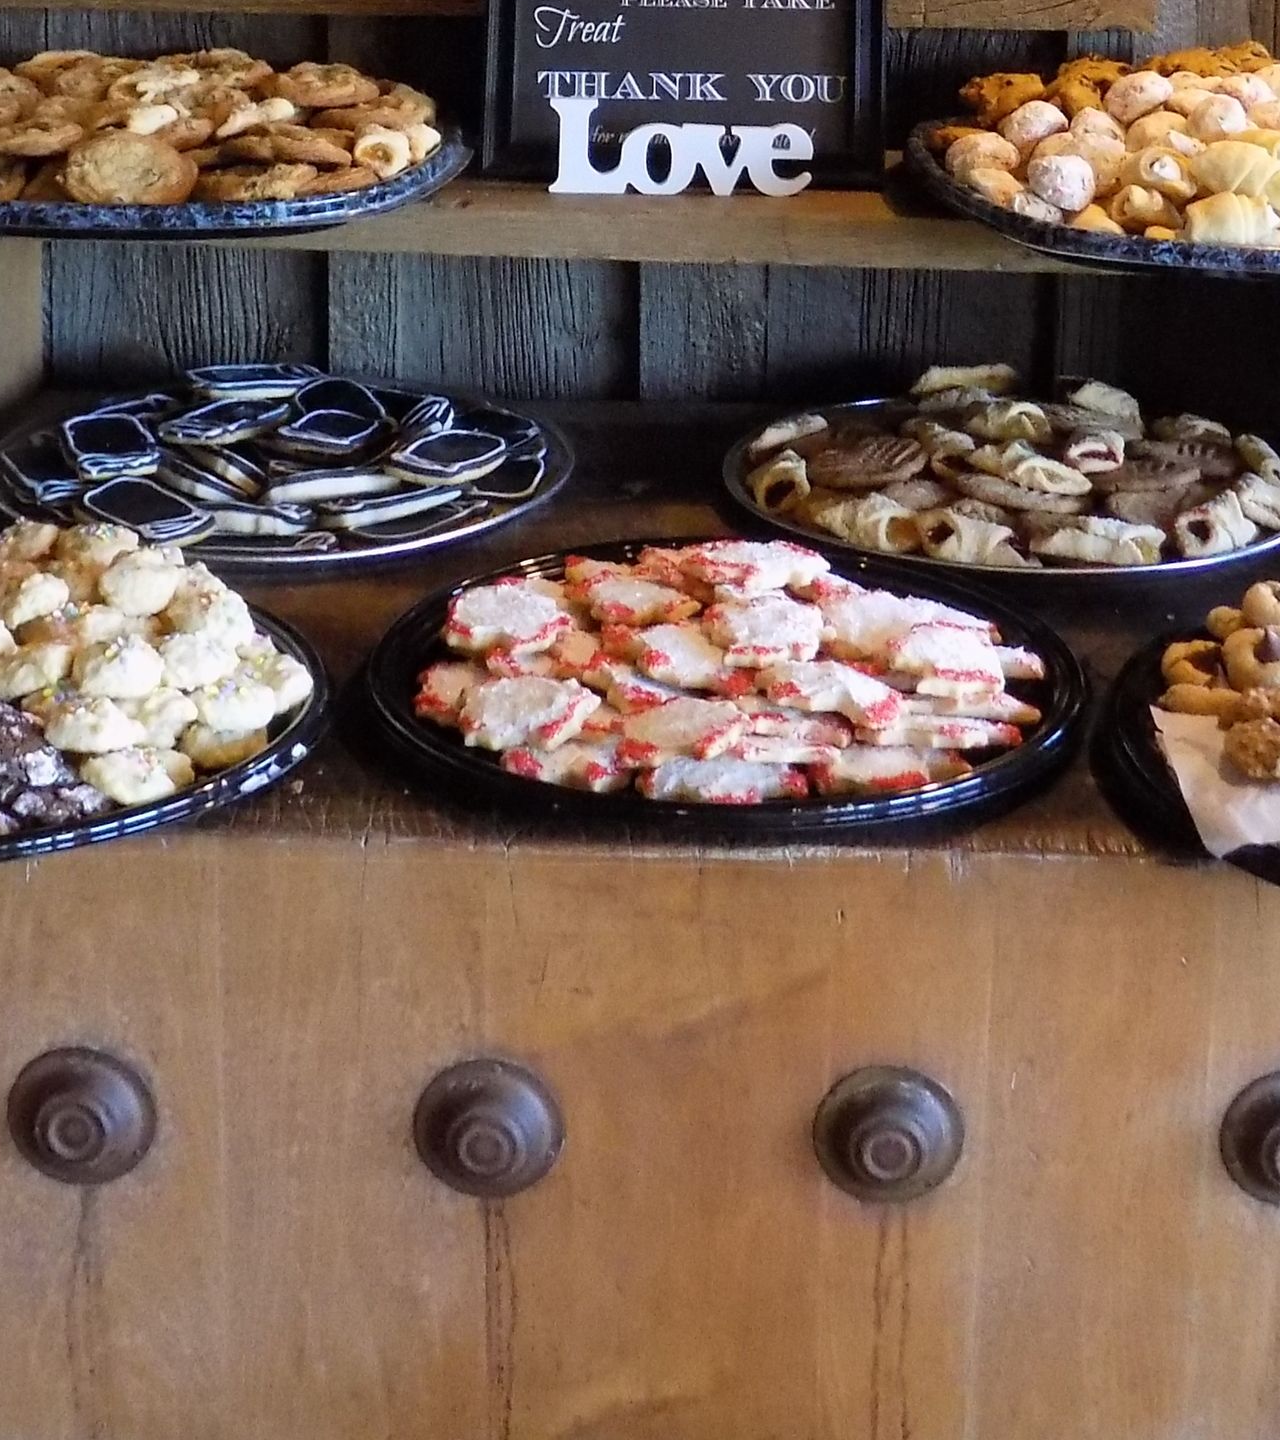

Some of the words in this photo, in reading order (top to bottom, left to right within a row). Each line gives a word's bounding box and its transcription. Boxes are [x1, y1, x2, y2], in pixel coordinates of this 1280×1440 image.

[533, 5, 626, 49] Treat
[536, 70, 728, 101] THANK
[746, 73, 848, 104] YOU
[547, 97, 815, 198] Love
